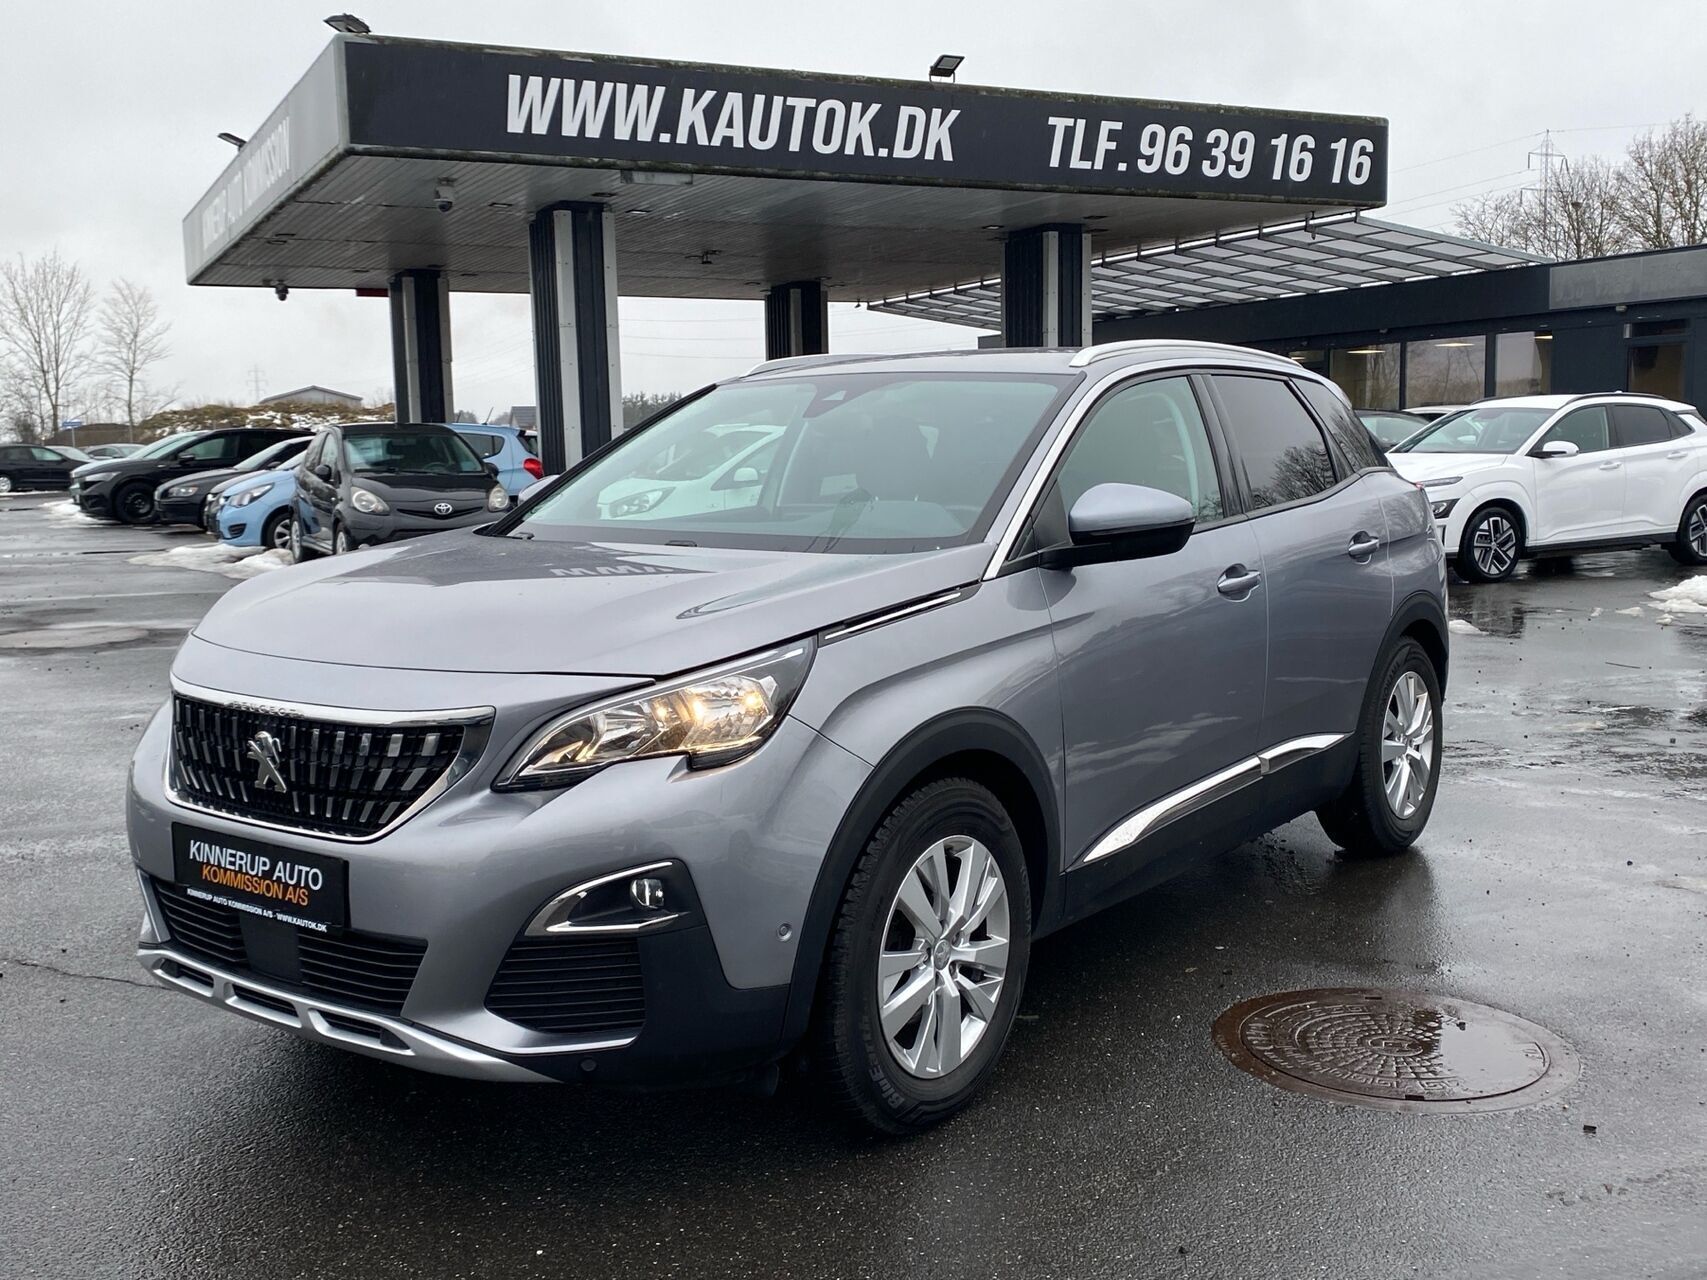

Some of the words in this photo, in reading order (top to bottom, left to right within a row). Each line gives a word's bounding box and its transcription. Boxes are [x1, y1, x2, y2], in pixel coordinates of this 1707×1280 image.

[507, 74, 961, 161] WWW.KAUTOK.DK
[1048, 116, 1128, 171] TLF.
[1137, 123, 1193, 175] 96
[1201, 128, 1255, 179] 39
[1271, 133, 1316, 182] 16
[1330, 137, 1374, 186] 16
[189, 839, 270, 877] KINNERUP
[273, 861, 323, 891] AUTO
[202, 864, 283, 899] KOMMISSION
[285, 885, 309, 906] A/S
[213, 896, 228, 906] AUTO
